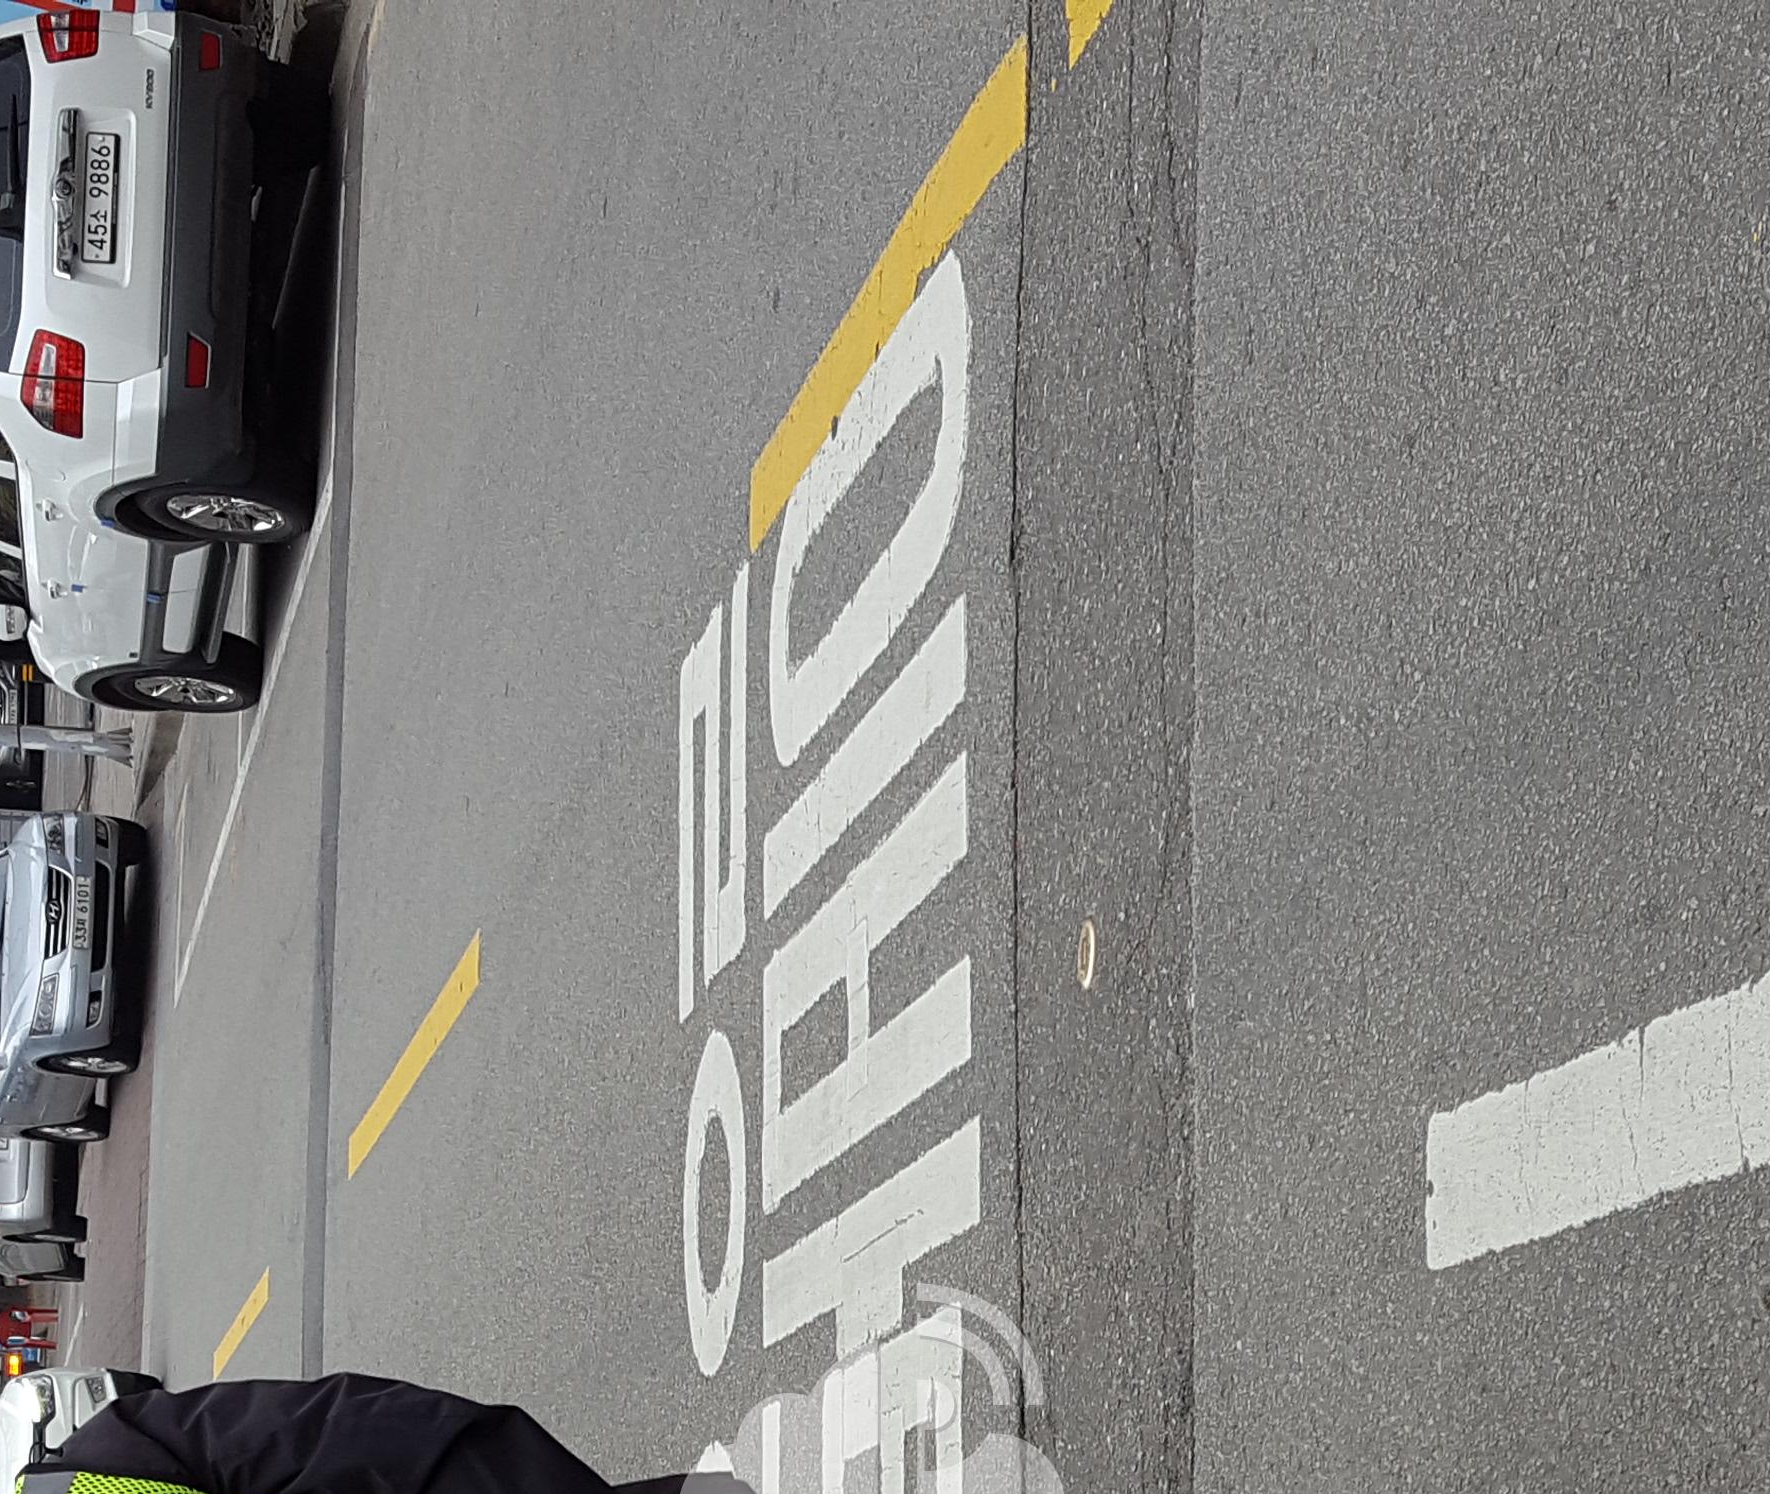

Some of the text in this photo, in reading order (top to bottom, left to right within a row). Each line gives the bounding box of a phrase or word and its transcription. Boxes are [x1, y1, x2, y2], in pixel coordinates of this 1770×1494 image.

[87, 145, 111, 251] 45소 9886
[75, 883, 89, 913] 6101
